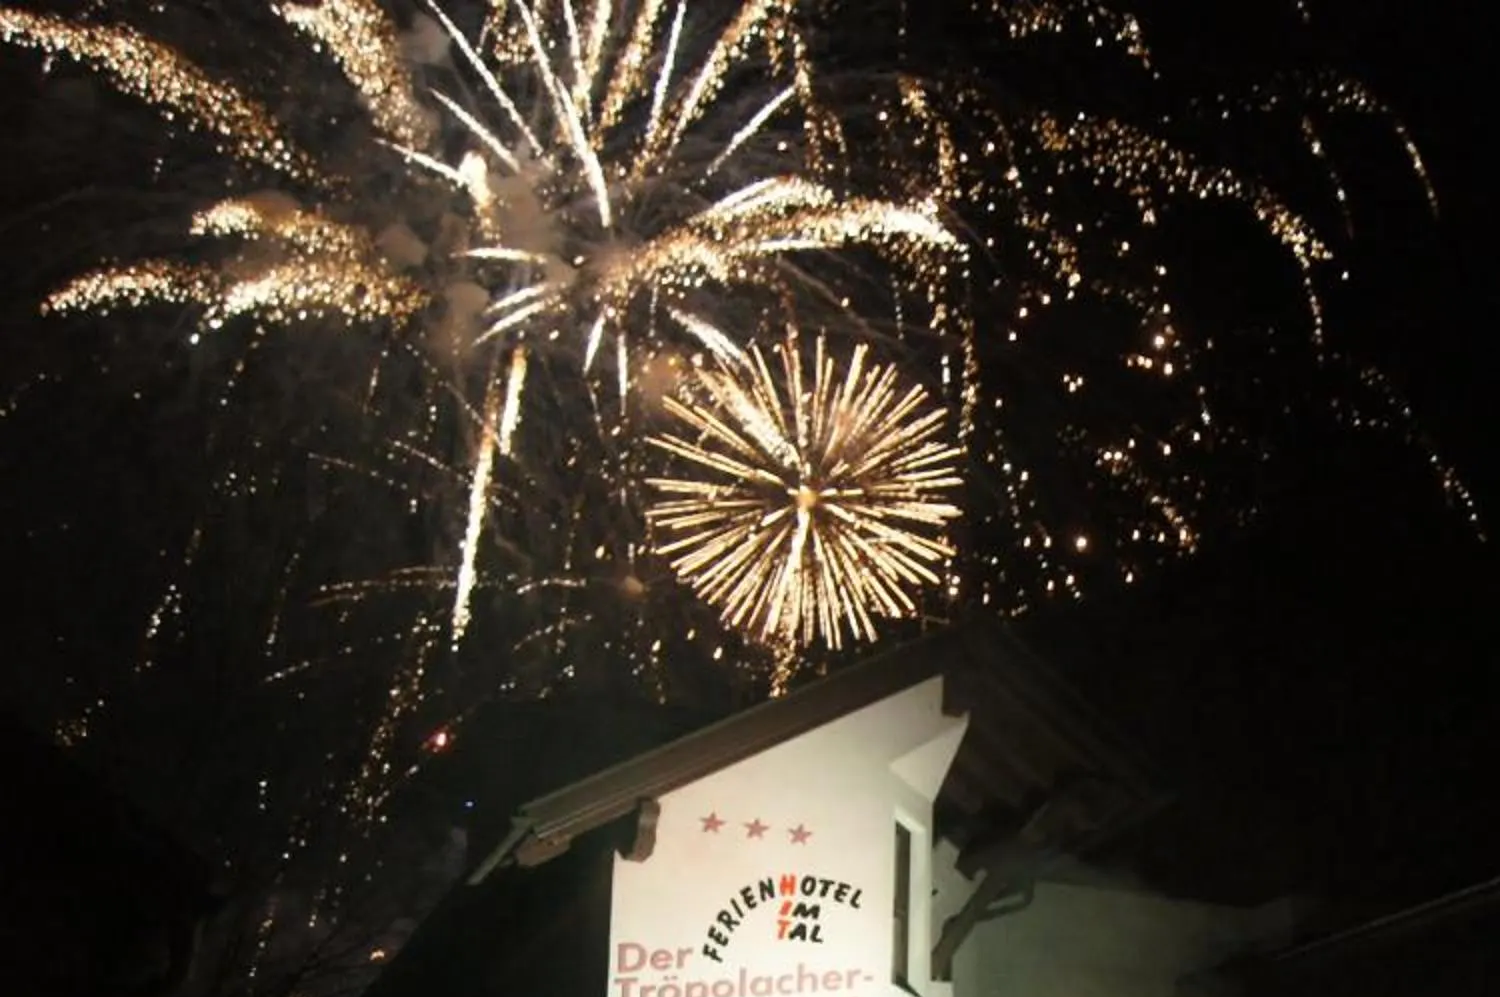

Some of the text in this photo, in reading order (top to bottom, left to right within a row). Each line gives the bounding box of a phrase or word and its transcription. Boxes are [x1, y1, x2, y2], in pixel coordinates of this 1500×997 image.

[702, 873, 863, 962] FERIENHOTEL
[779, 901, 821, 920] IM
[777, 919, 823, 943] TAL
[617, 942, 693, 974] Der
